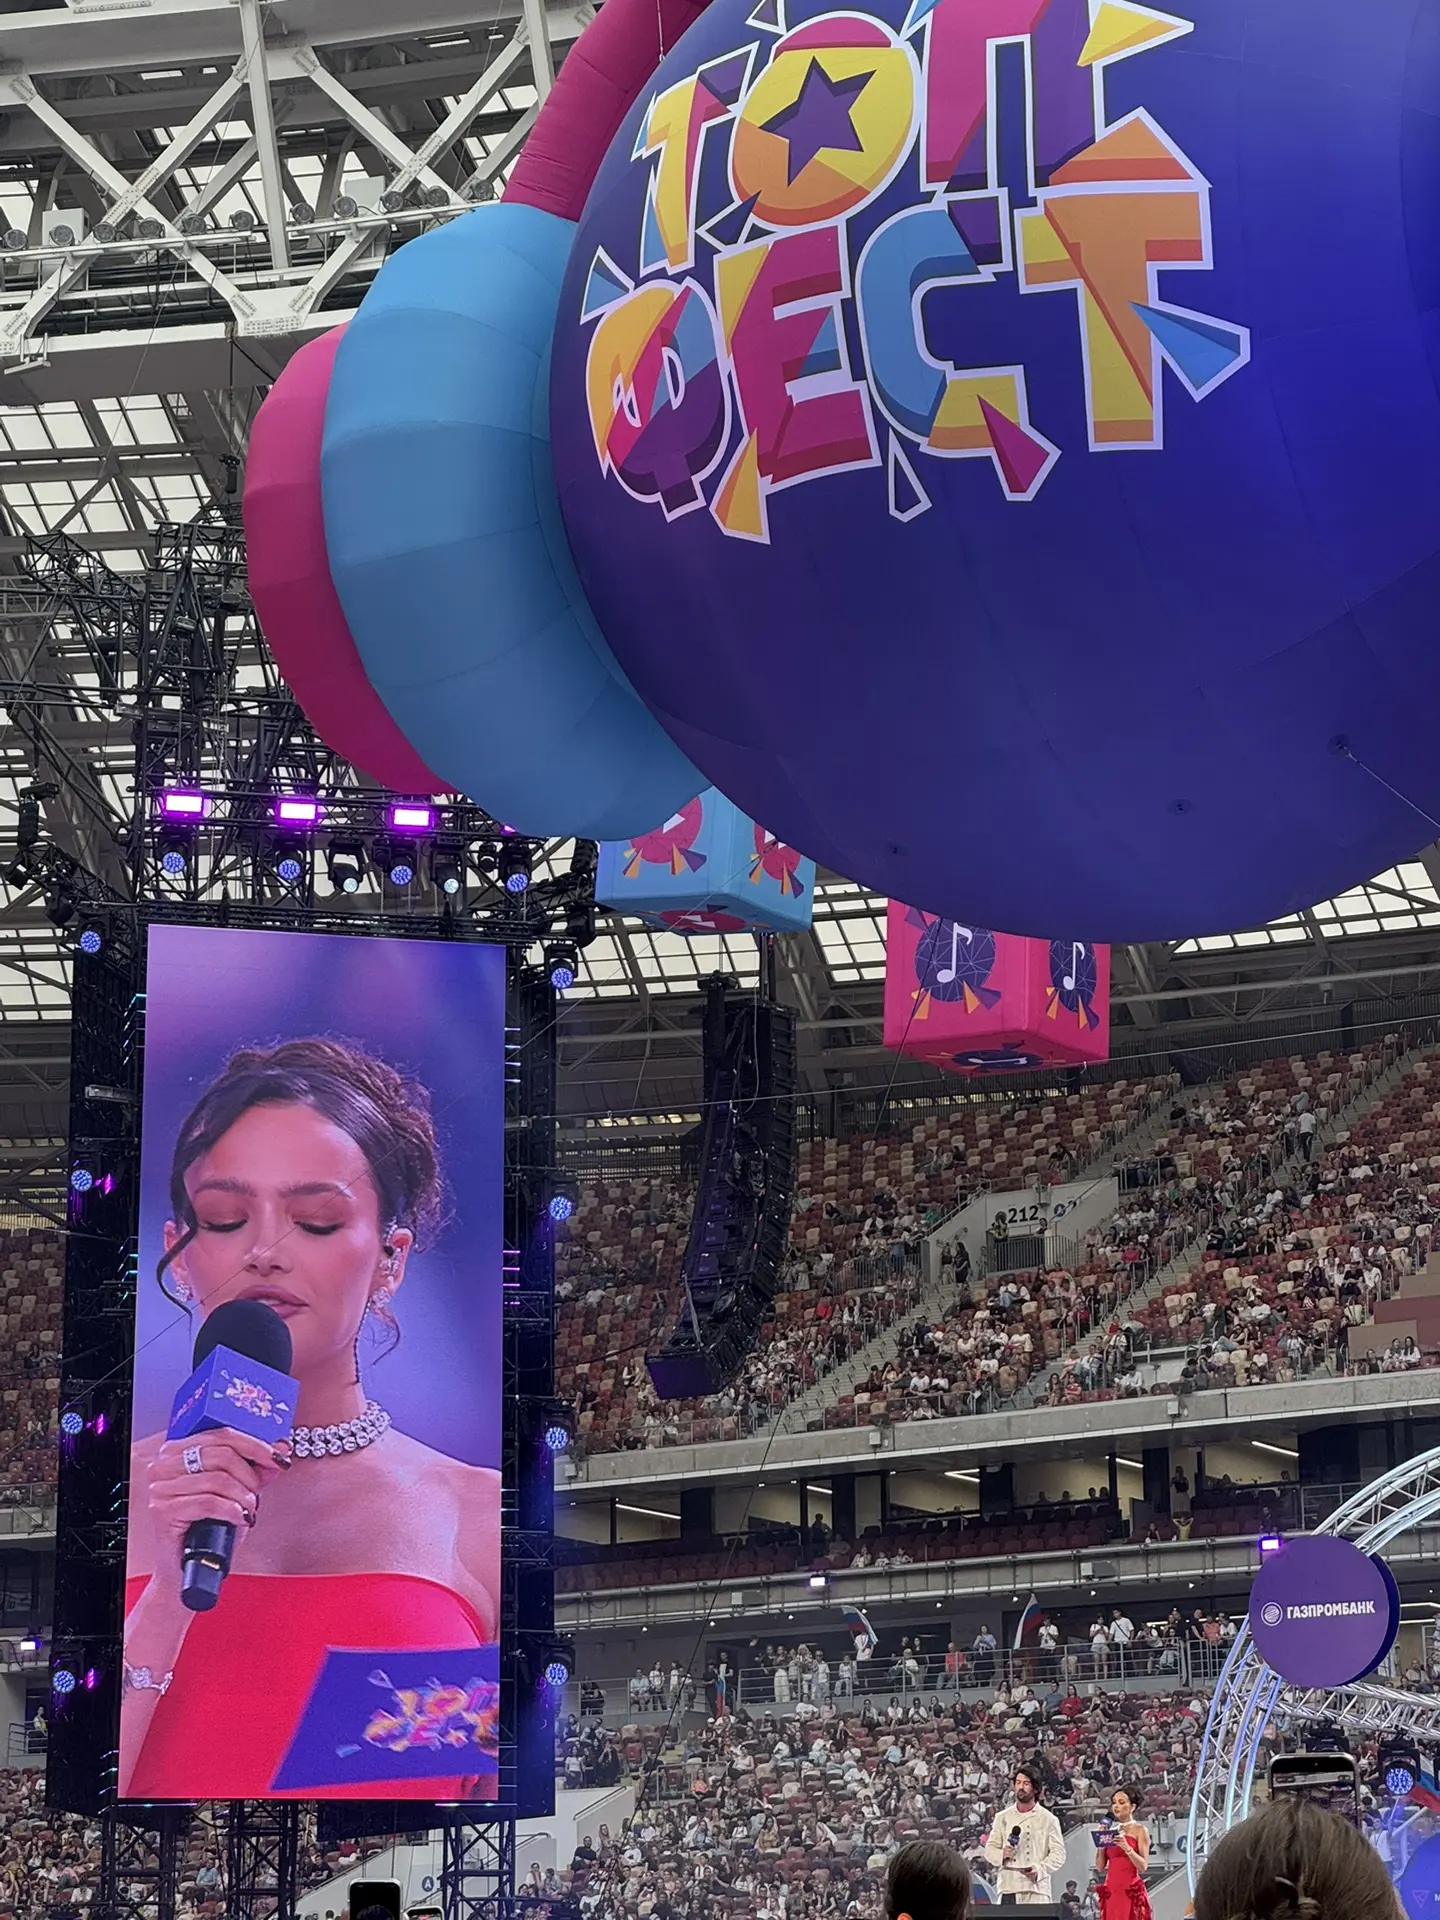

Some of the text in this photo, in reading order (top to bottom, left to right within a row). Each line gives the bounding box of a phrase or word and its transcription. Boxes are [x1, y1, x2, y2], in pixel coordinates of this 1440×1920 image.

[632, 0, 1099, 275] ТОП
[586, 186, 1213, 521] ФЕСТ
[1007, 1204, 1039, 1224] 212
[1286, 1600, 1376, 1619] ГАЗПРОМБАНК
